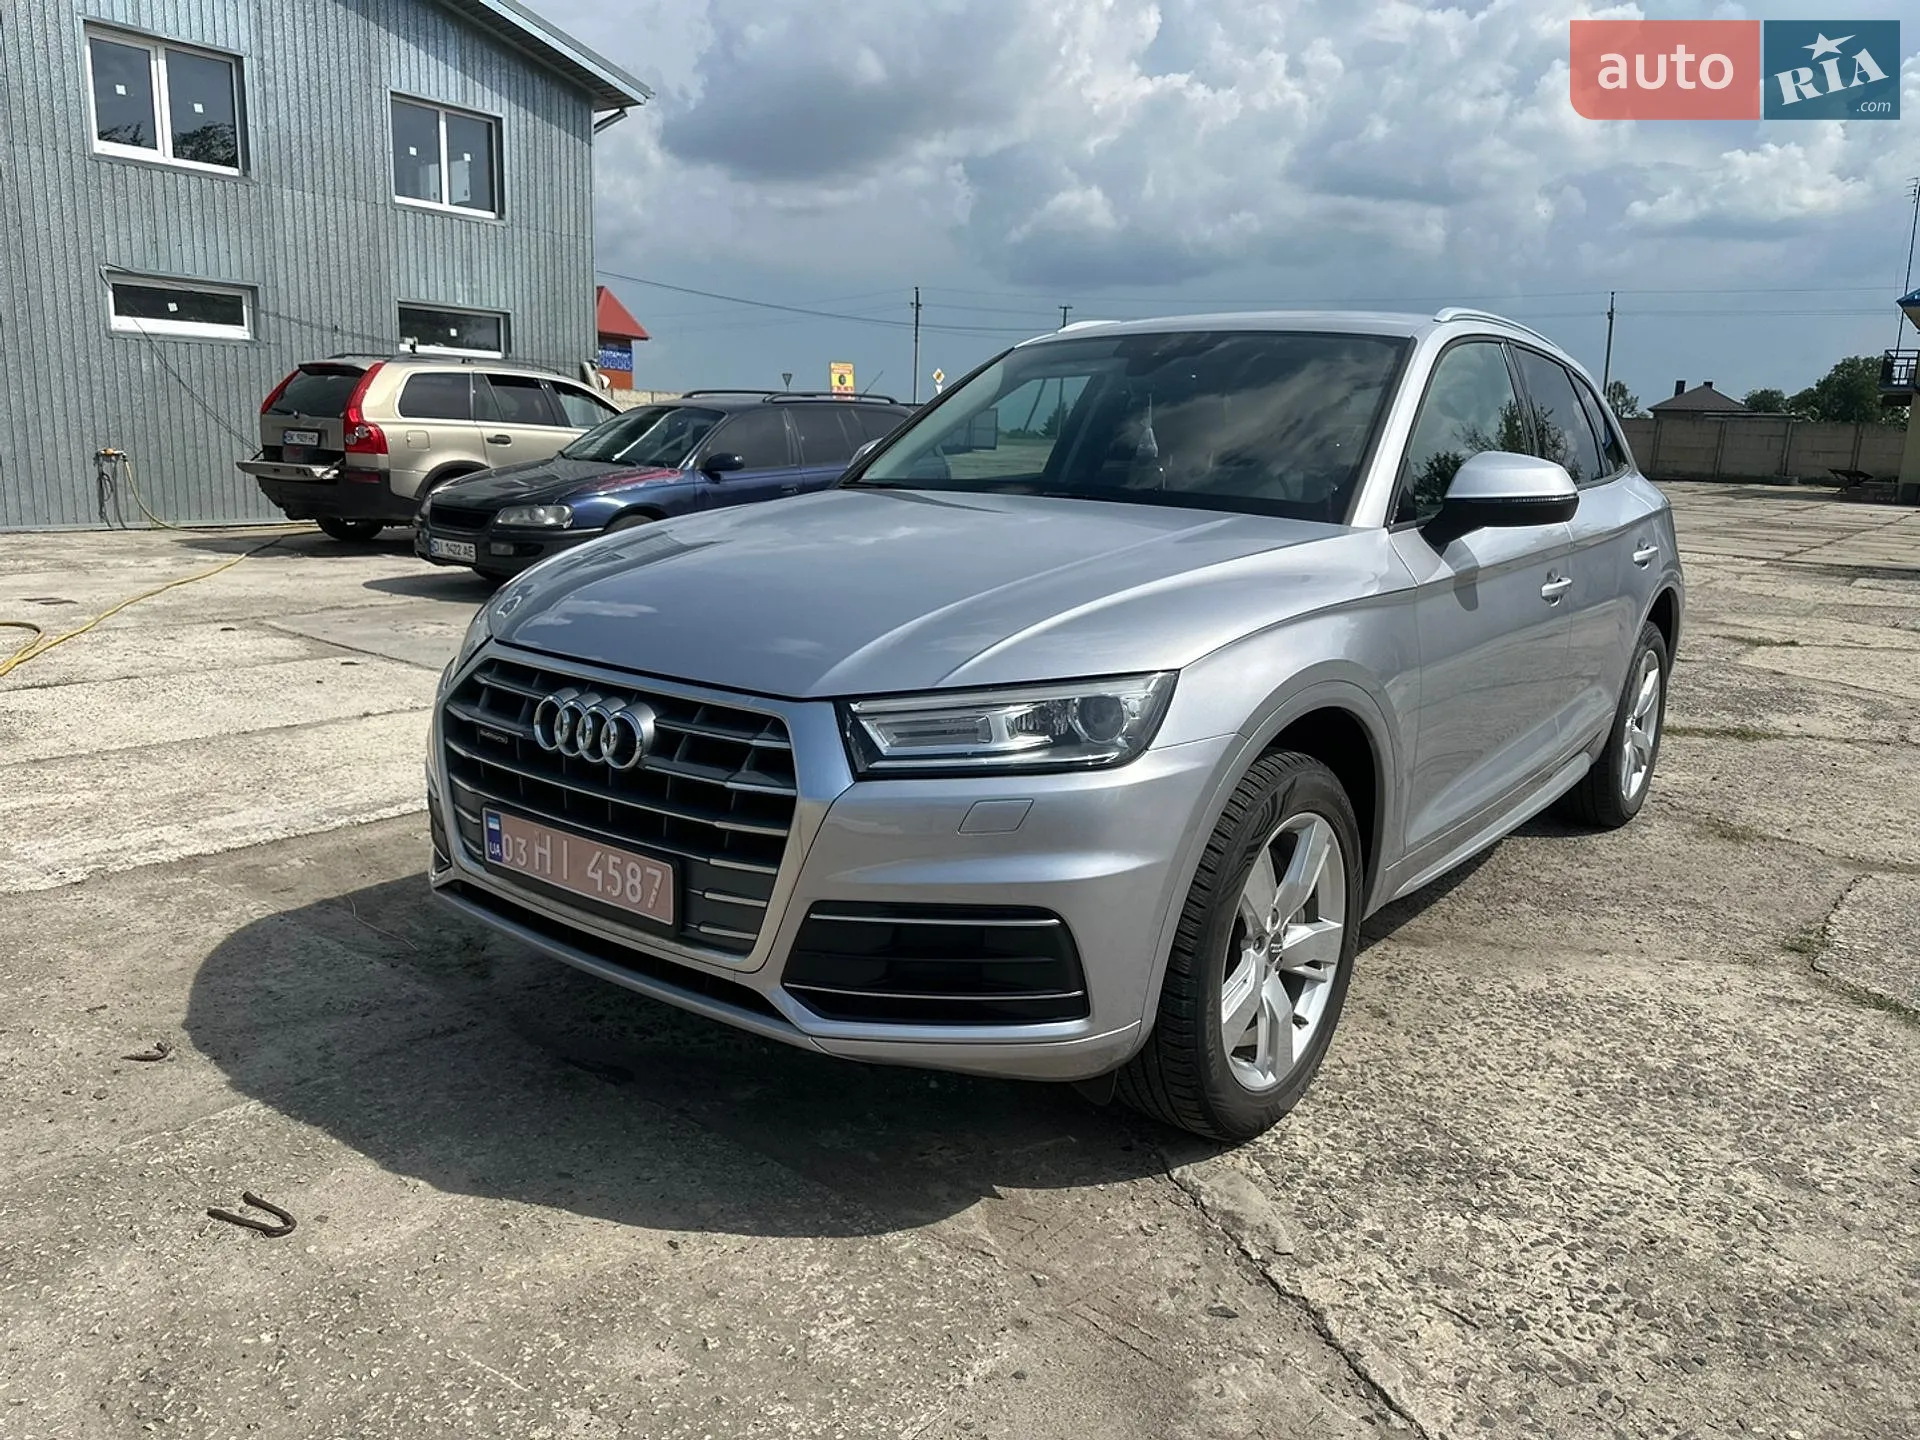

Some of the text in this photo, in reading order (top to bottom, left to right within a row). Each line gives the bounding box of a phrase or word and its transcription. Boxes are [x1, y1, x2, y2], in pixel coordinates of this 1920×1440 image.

[489, 841, 501, 856] UA
[502, 833, 528, 867] 03
[586, 851, 664, 910] 4587
